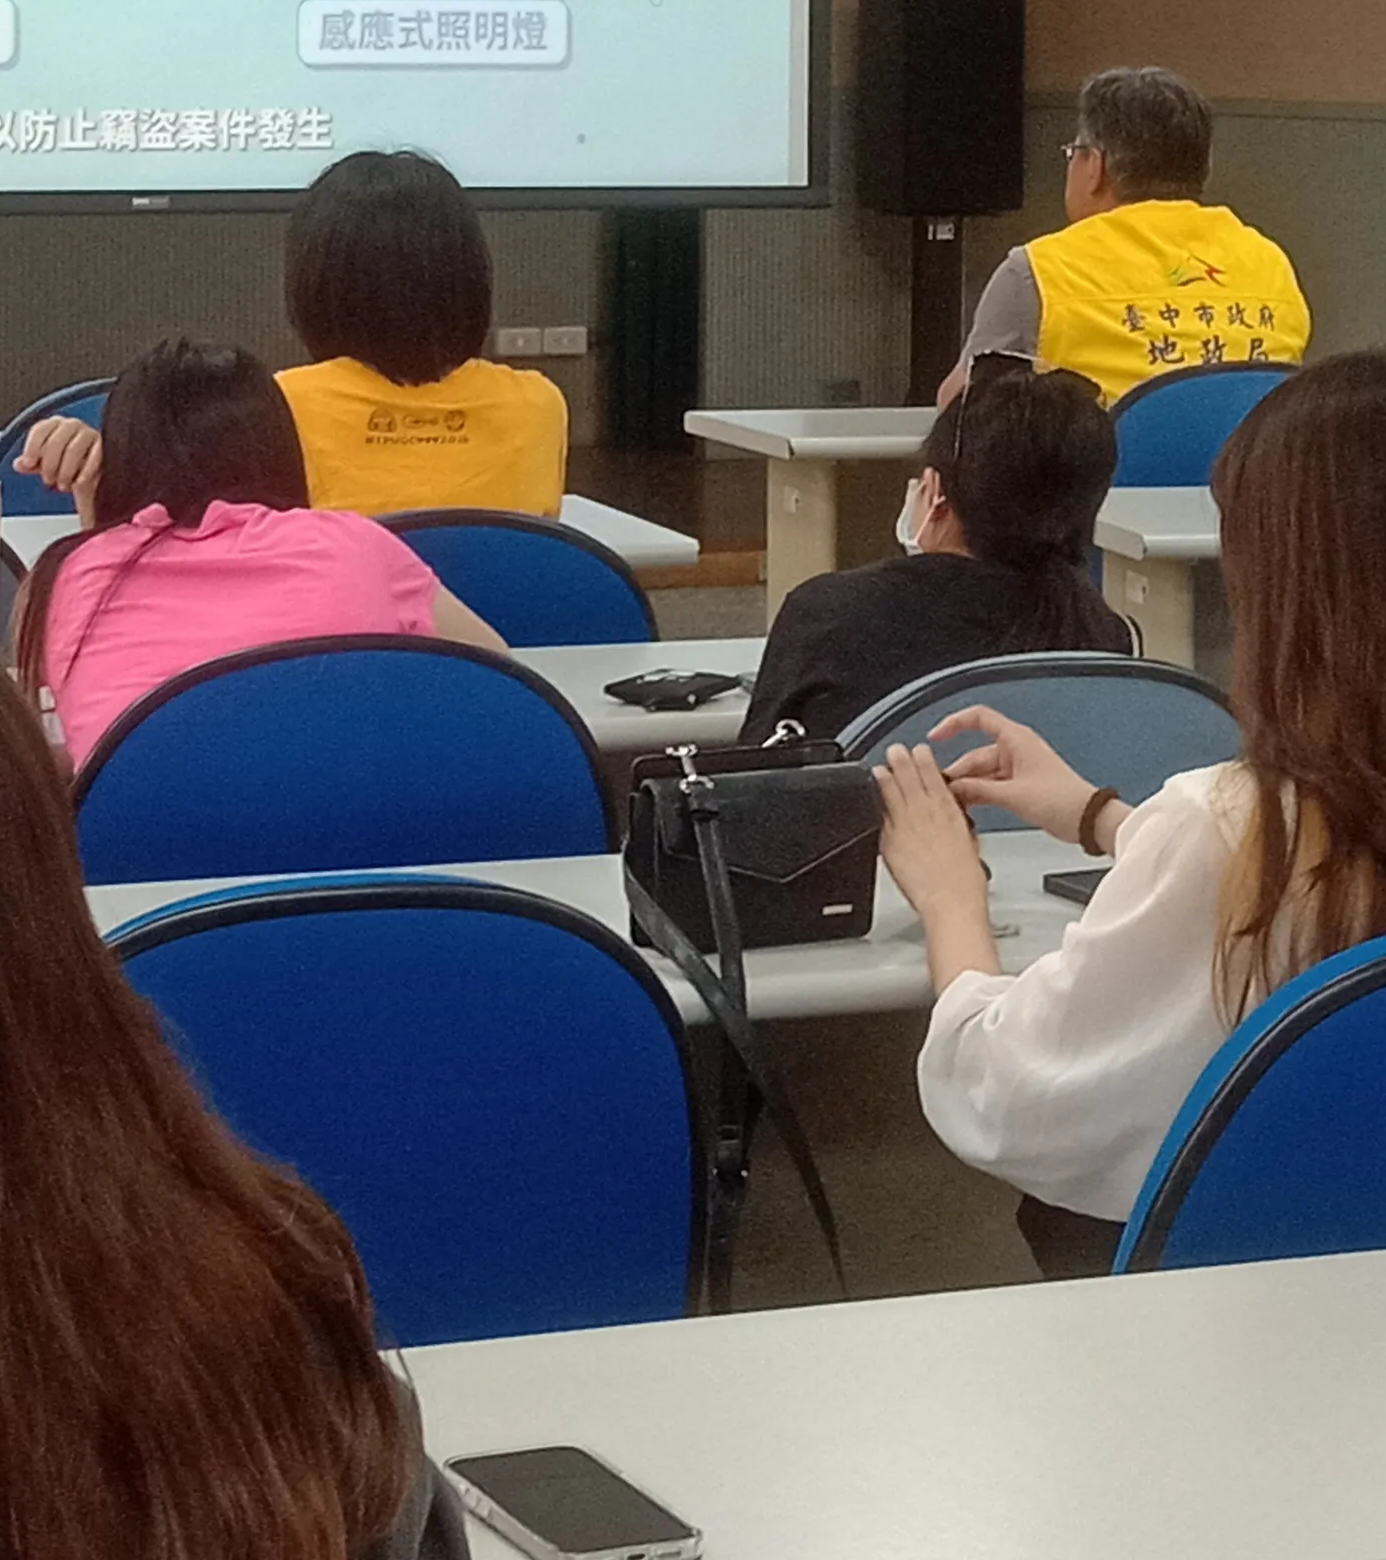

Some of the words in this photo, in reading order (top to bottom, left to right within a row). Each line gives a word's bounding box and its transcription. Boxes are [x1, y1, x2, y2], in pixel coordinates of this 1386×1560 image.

[318, 9, 548, 51] 感應式照明燈
[1121, 301, 1275, 333] 臺中市政府
[1148, 333, 1269, 365] 地政局
